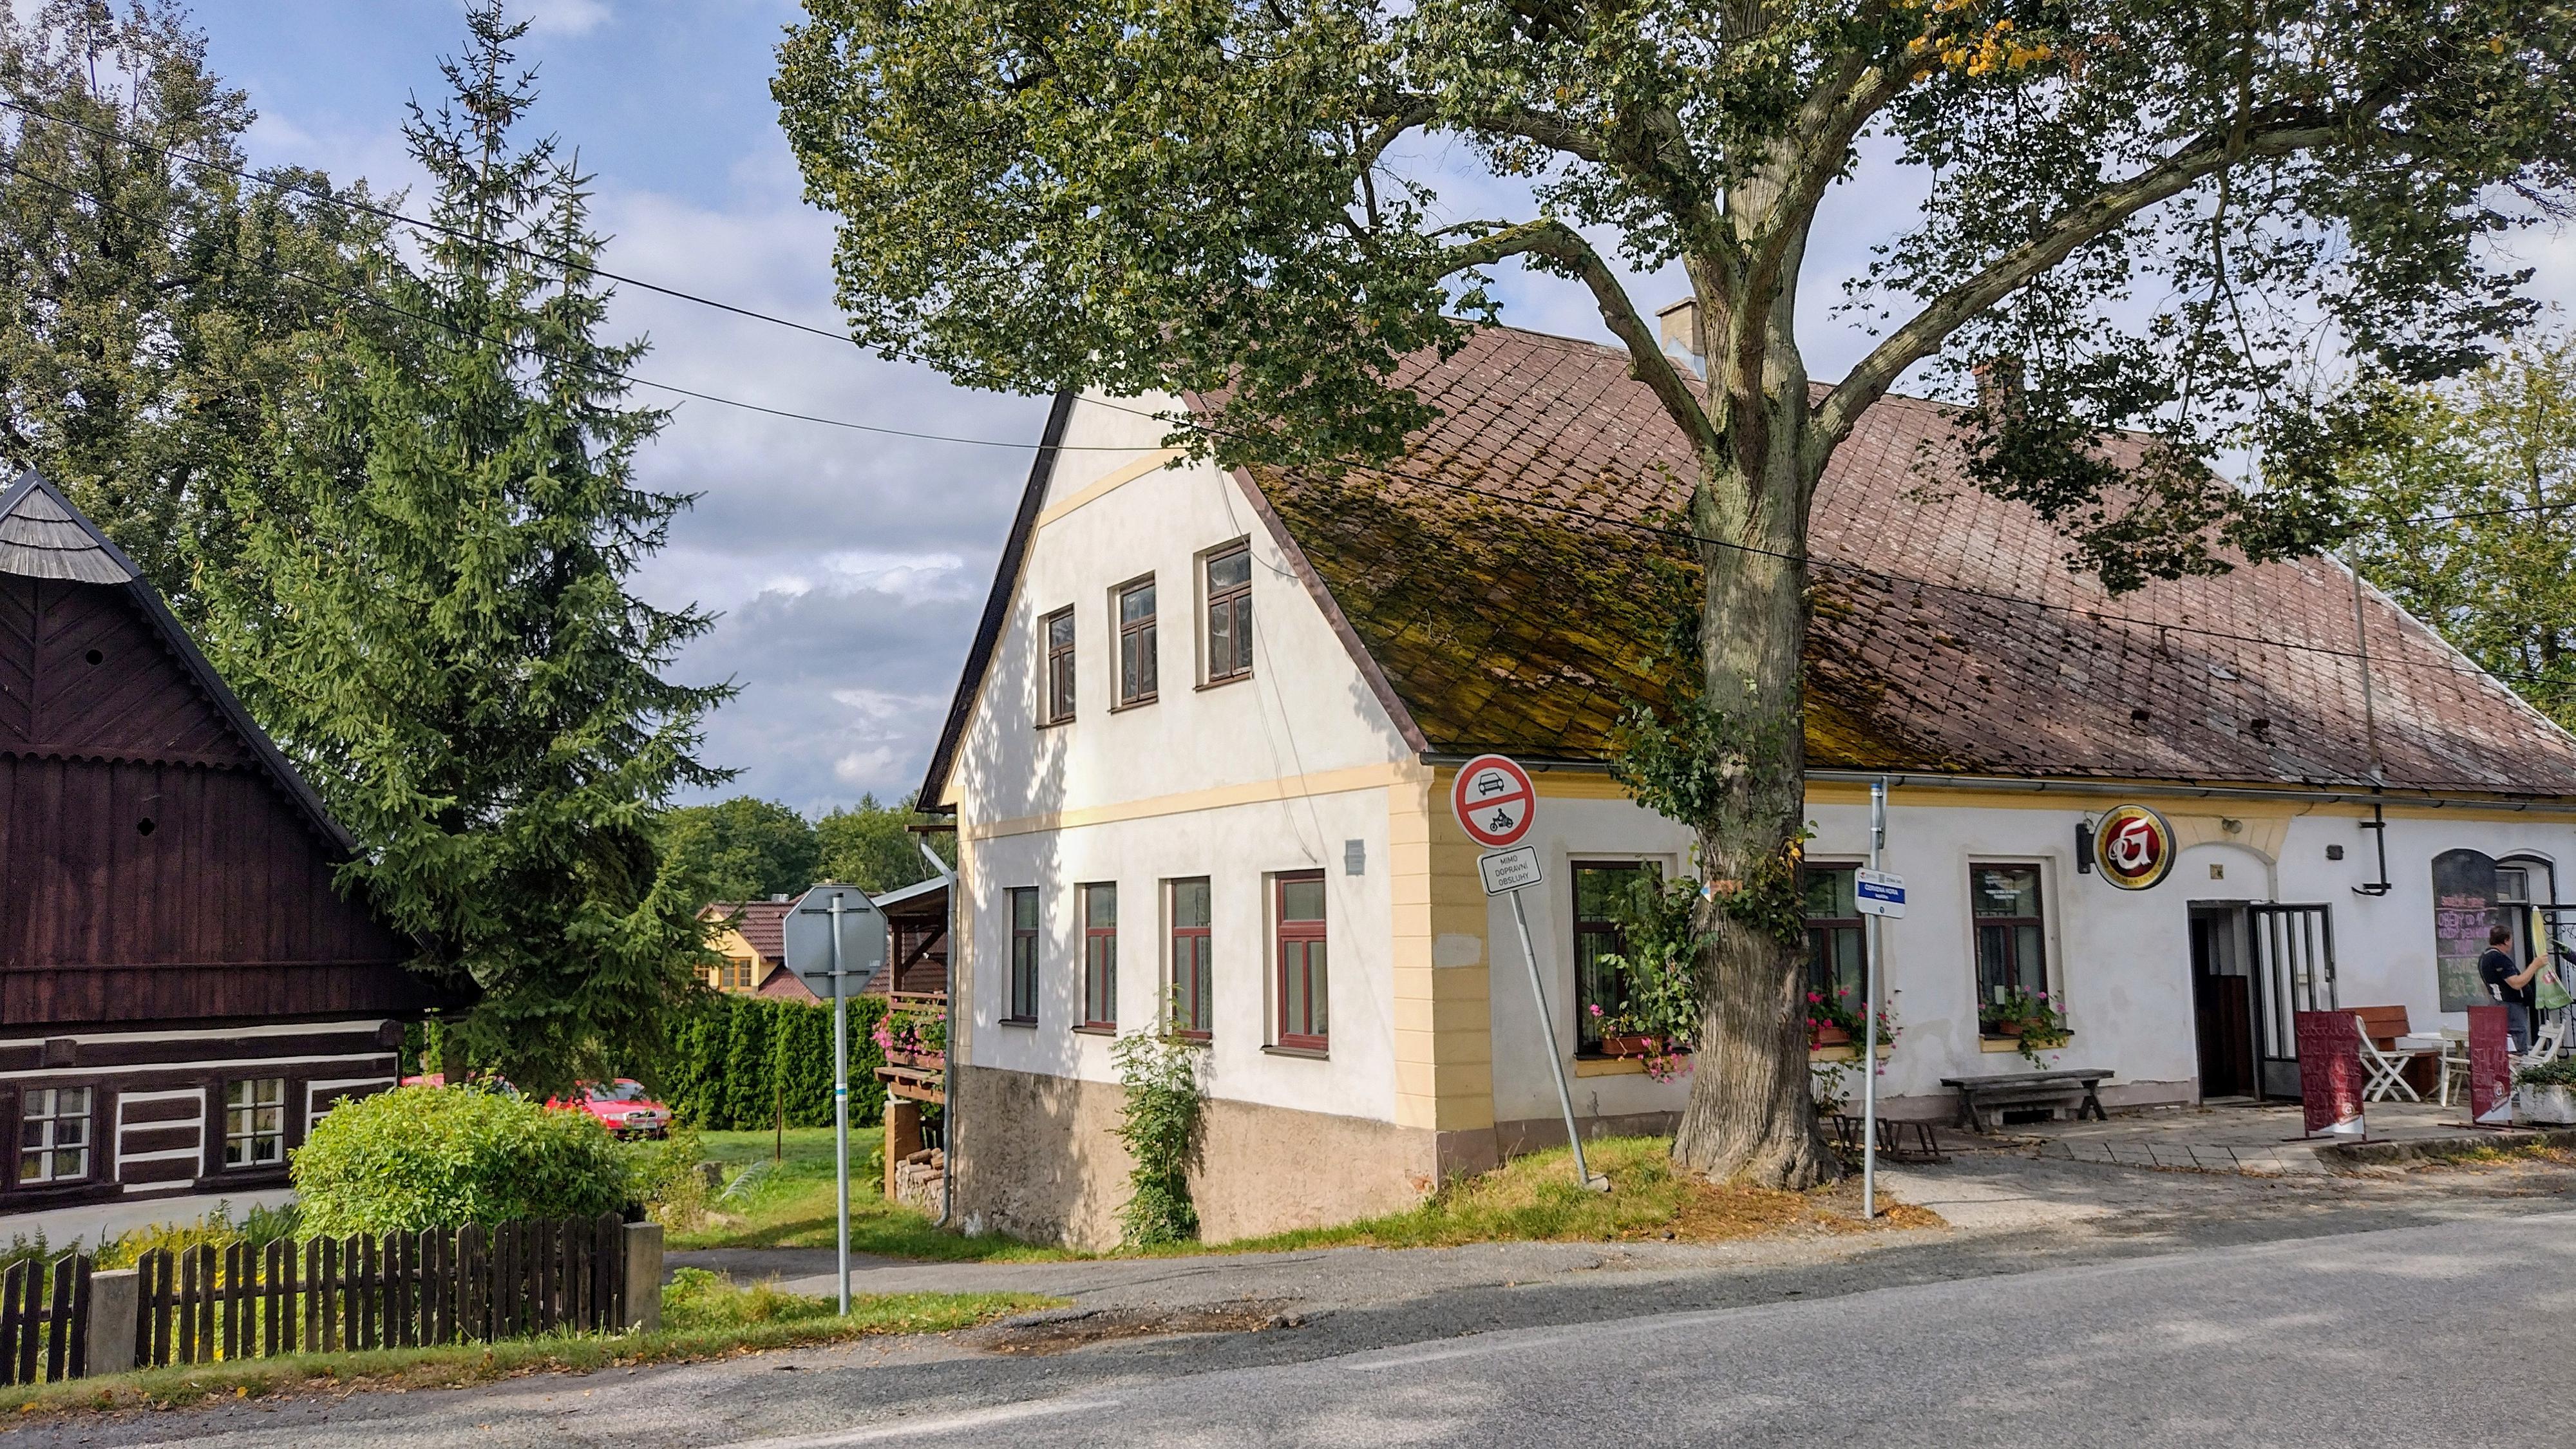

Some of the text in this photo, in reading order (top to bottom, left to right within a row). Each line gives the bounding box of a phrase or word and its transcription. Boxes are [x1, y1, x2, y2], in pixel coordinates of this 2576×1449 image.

[1500, 855, 1518, 865] MIMO
[1495, 860, 1528, 876] DOPRAVNÍ
[1499, 872, 1529, 886] OBSLUHY
